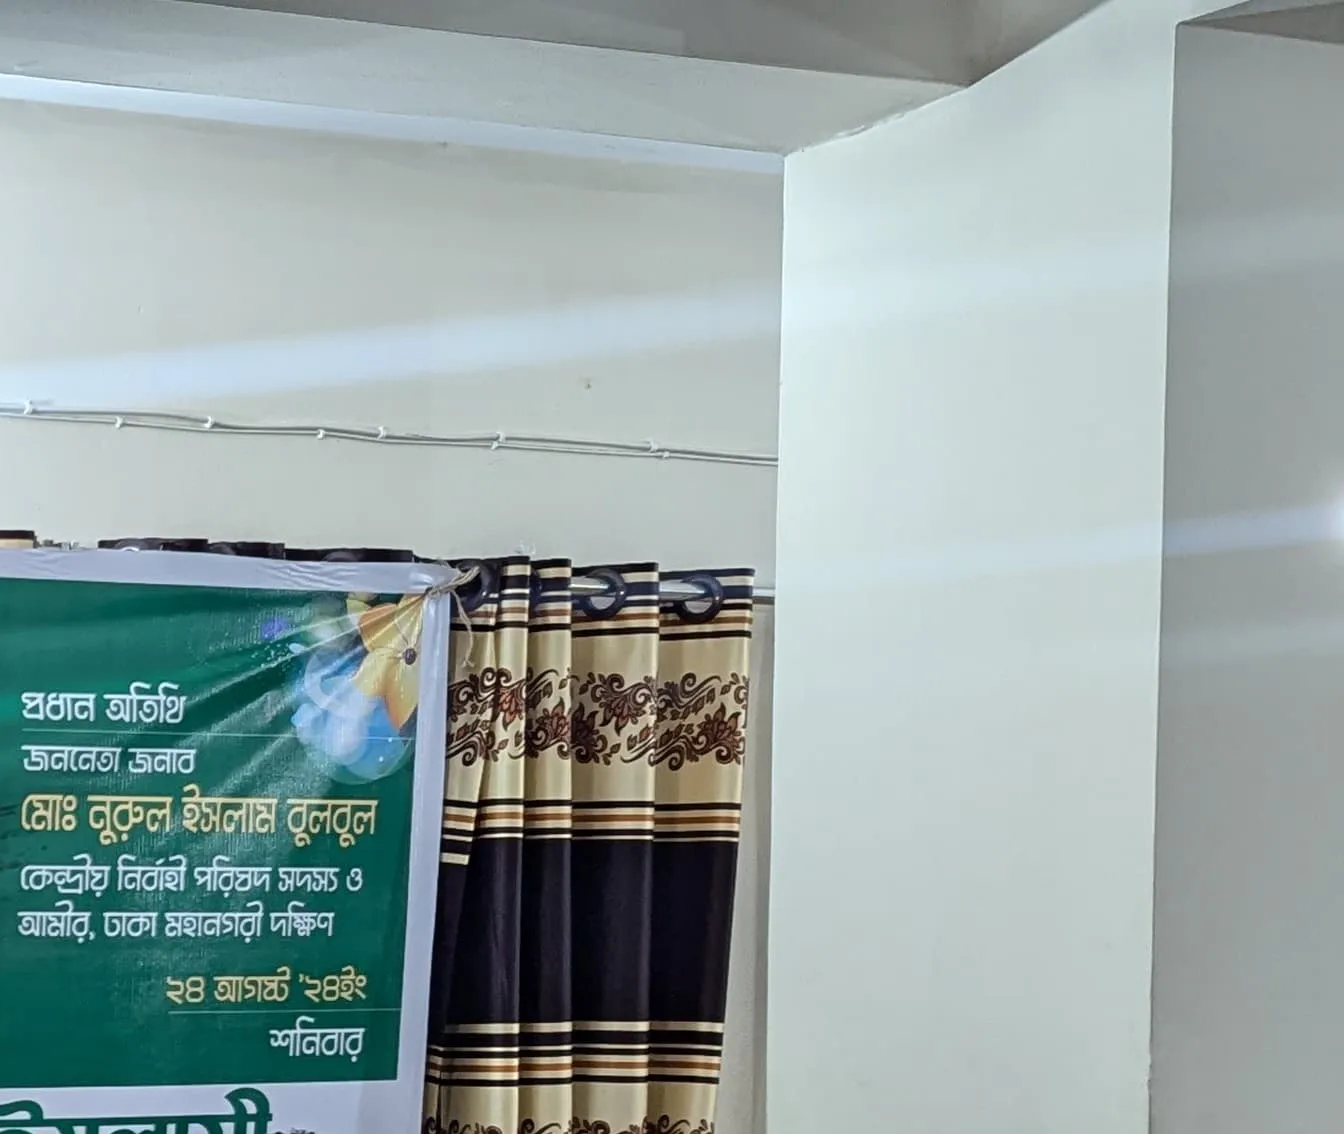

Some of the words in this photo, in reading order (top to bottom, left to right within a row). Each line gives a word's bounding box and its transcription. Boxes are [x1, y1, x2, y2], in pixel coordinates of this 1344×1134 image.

[21, 691, 95, 724] প্রধান
[105, 681, 186, 725] অতিথি
[21, 745, 120, 774] জননেতা
[128, 748, 196, 775] জনাব
[20, 794, 78, 832] মোঃ
[181, 784, 278, 834] ইসলাম
[20, 854, 111, 897] কেন্দ্রীয়
[116, 854, 187, 892] নির্বাহী
[194, 855, 272, 898] পরিষদ
[278, 866, 340, 892] সদস্য
[346, 867, 363, 892] ও
[17, 900, 95, 943] আমীর,
[103, 911, 158, 937] ঢাকা
[164, 902, 264, 943] মহানগরী
[269, 901, 334, 937] দক্ষিণ
[166, 976, 205, 1004] ২৪
[269, 1016, 365, 1062] শনিবার
